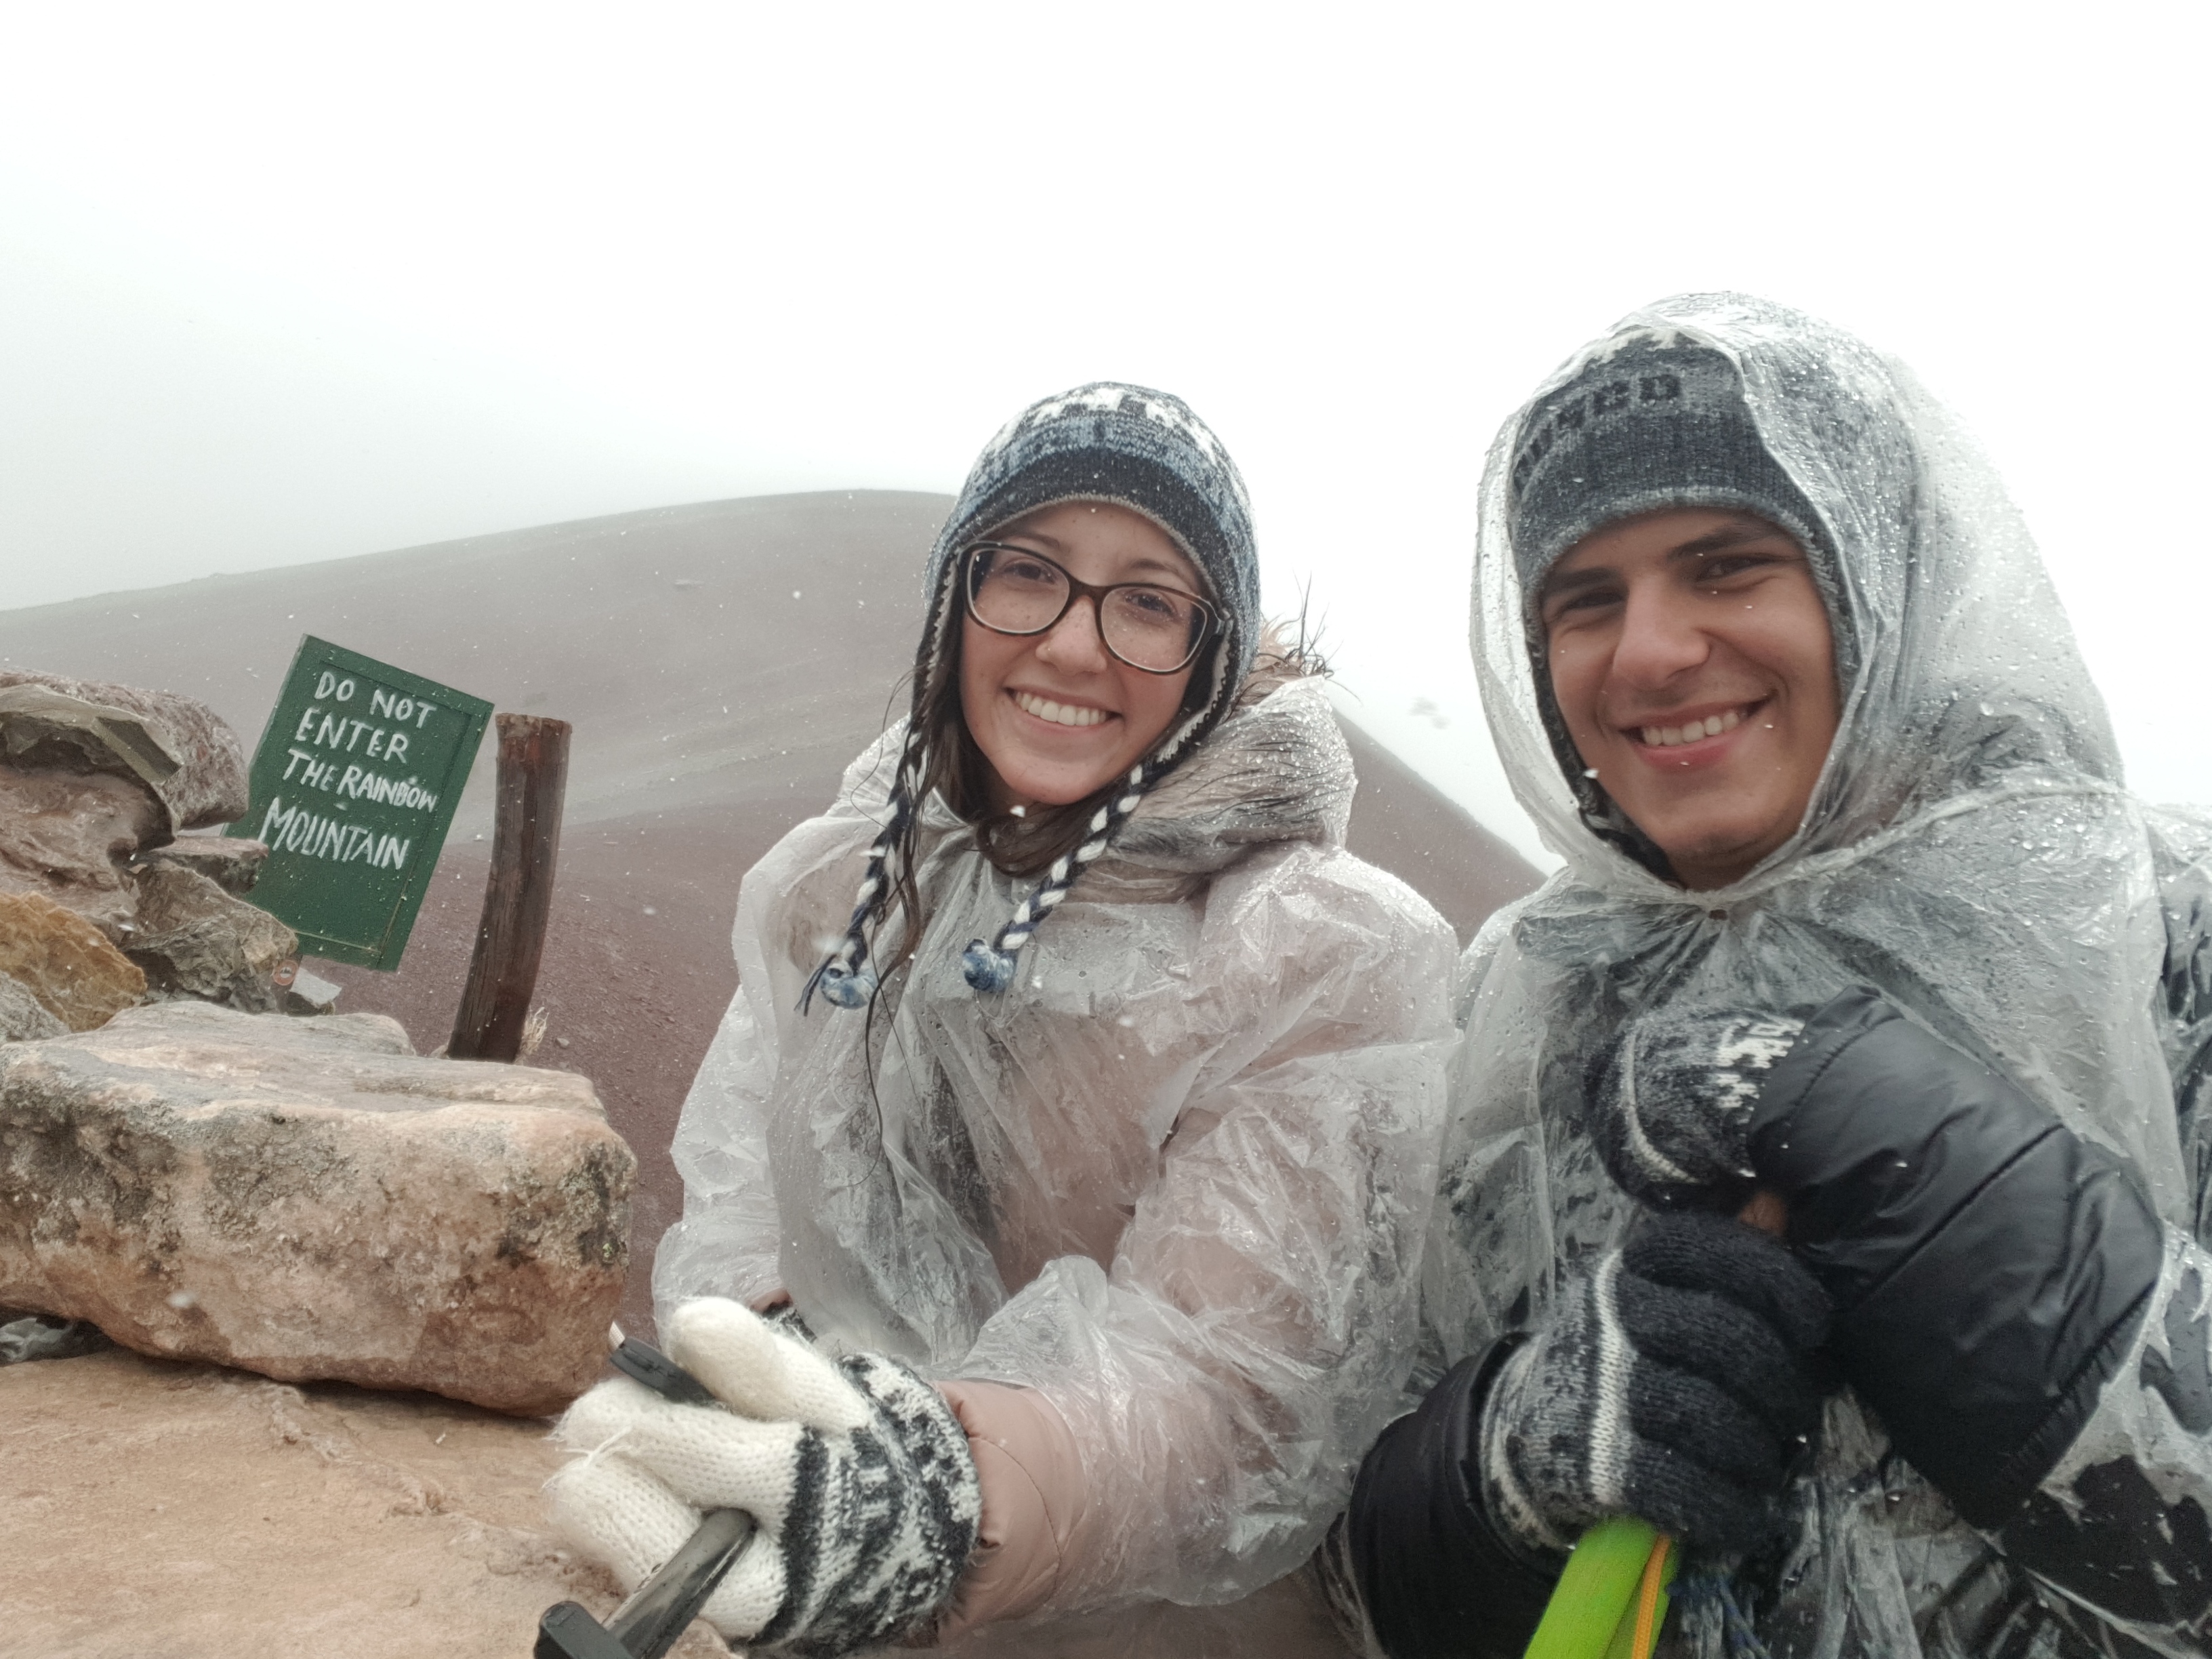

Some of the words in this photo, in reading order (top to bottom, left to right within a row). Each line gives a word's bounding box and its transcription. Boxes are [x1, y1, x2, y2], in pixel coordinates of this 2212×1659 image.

[314, 670, 354, 701] DO
[370, 689, 437, 728] NOT
[295, 707, 409, 763] ENTER
[283, 748, 337, 791] THE
[337, 765, 438, 812] RAINBOW
[258, 797, 409, 869] MOUNTAIN
